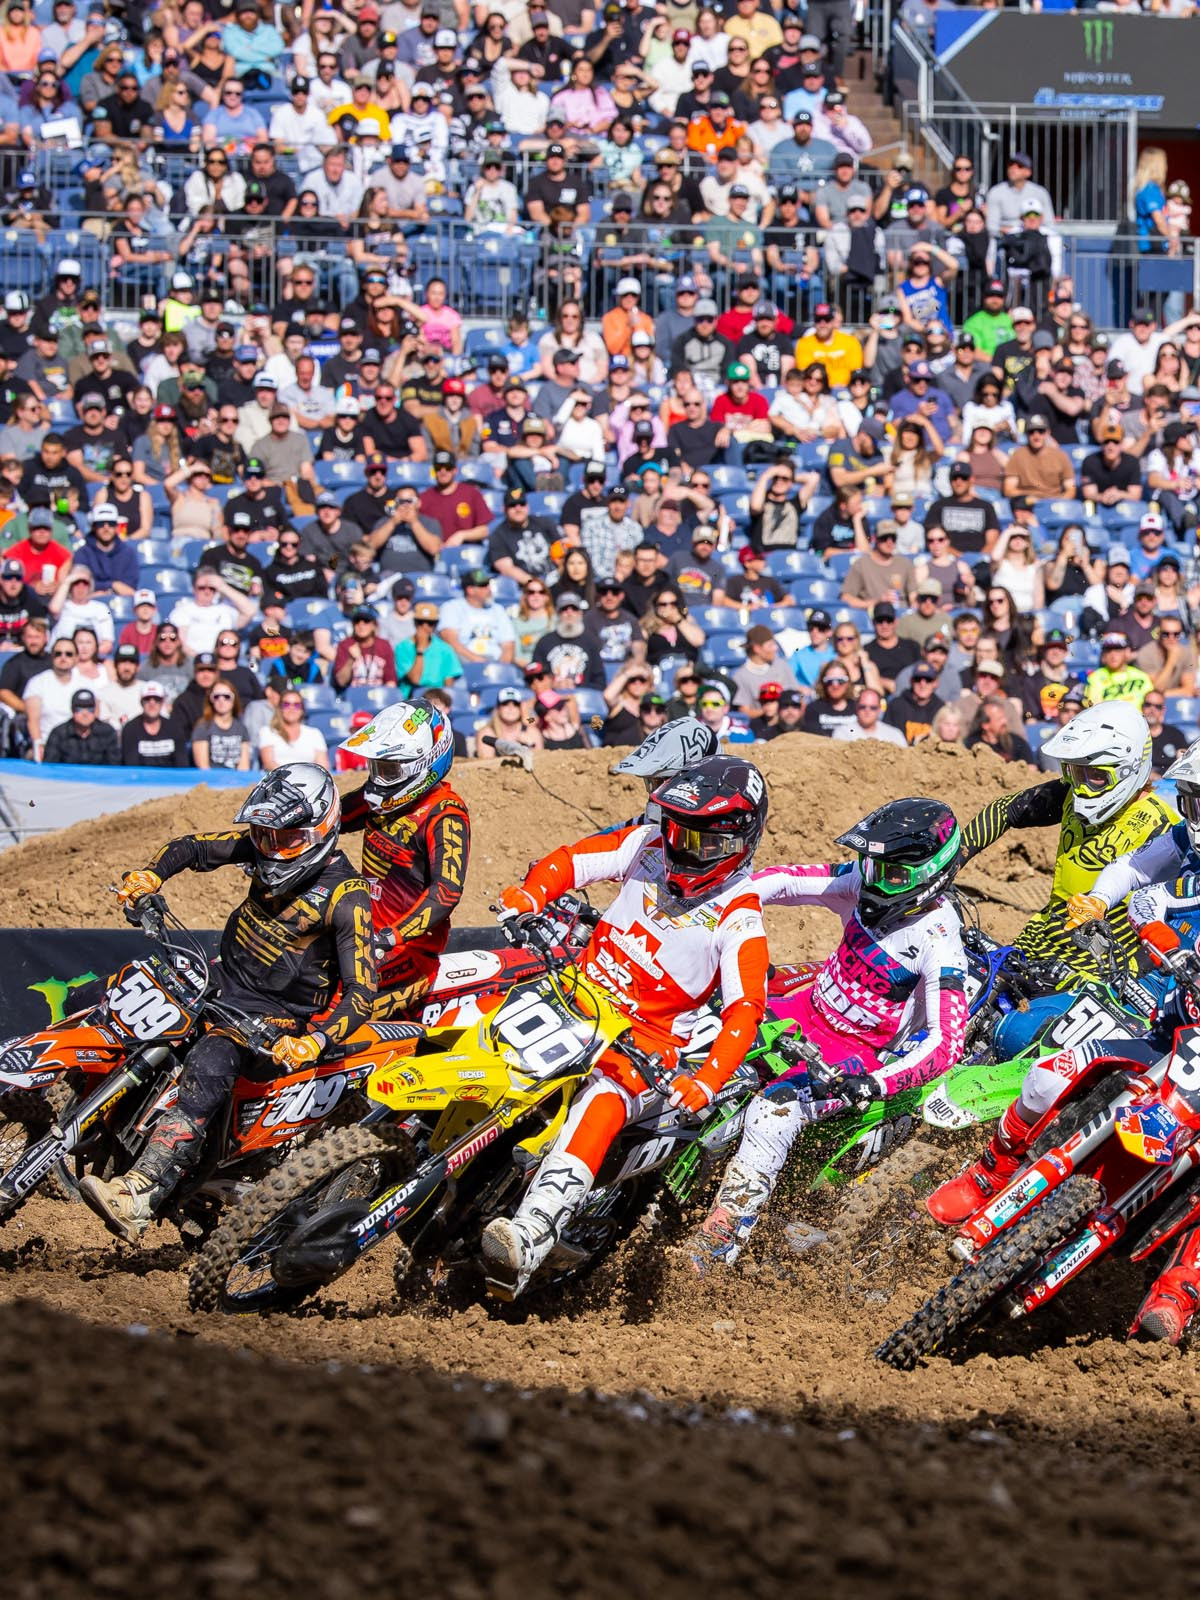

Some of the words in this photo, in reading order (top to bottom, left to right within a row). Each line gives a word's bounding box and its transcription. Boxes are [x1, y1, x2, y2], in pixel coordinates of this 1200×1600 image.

[403, 707, 430, 736] 942
[744, 769, 764, 805] 100
[442, 817, 463, 886] FXR
[343, 880, 370, 891] FXR
[609, 927, 631, 955] TOYOTA
[629, 947, 663, 980] REDLANDS
[448, 968, 477, 979] GUTS
[783, 972, 814, 986] DUNLOP
[109, 970, 181, 1041] 509
[492, 991, 588, 1079] 100
[457, 1071, 486, 1079] TUCKER
[262, 1073, 347, 1127] 509
[1054, 1244, 1091, 1282] DUNLOP
